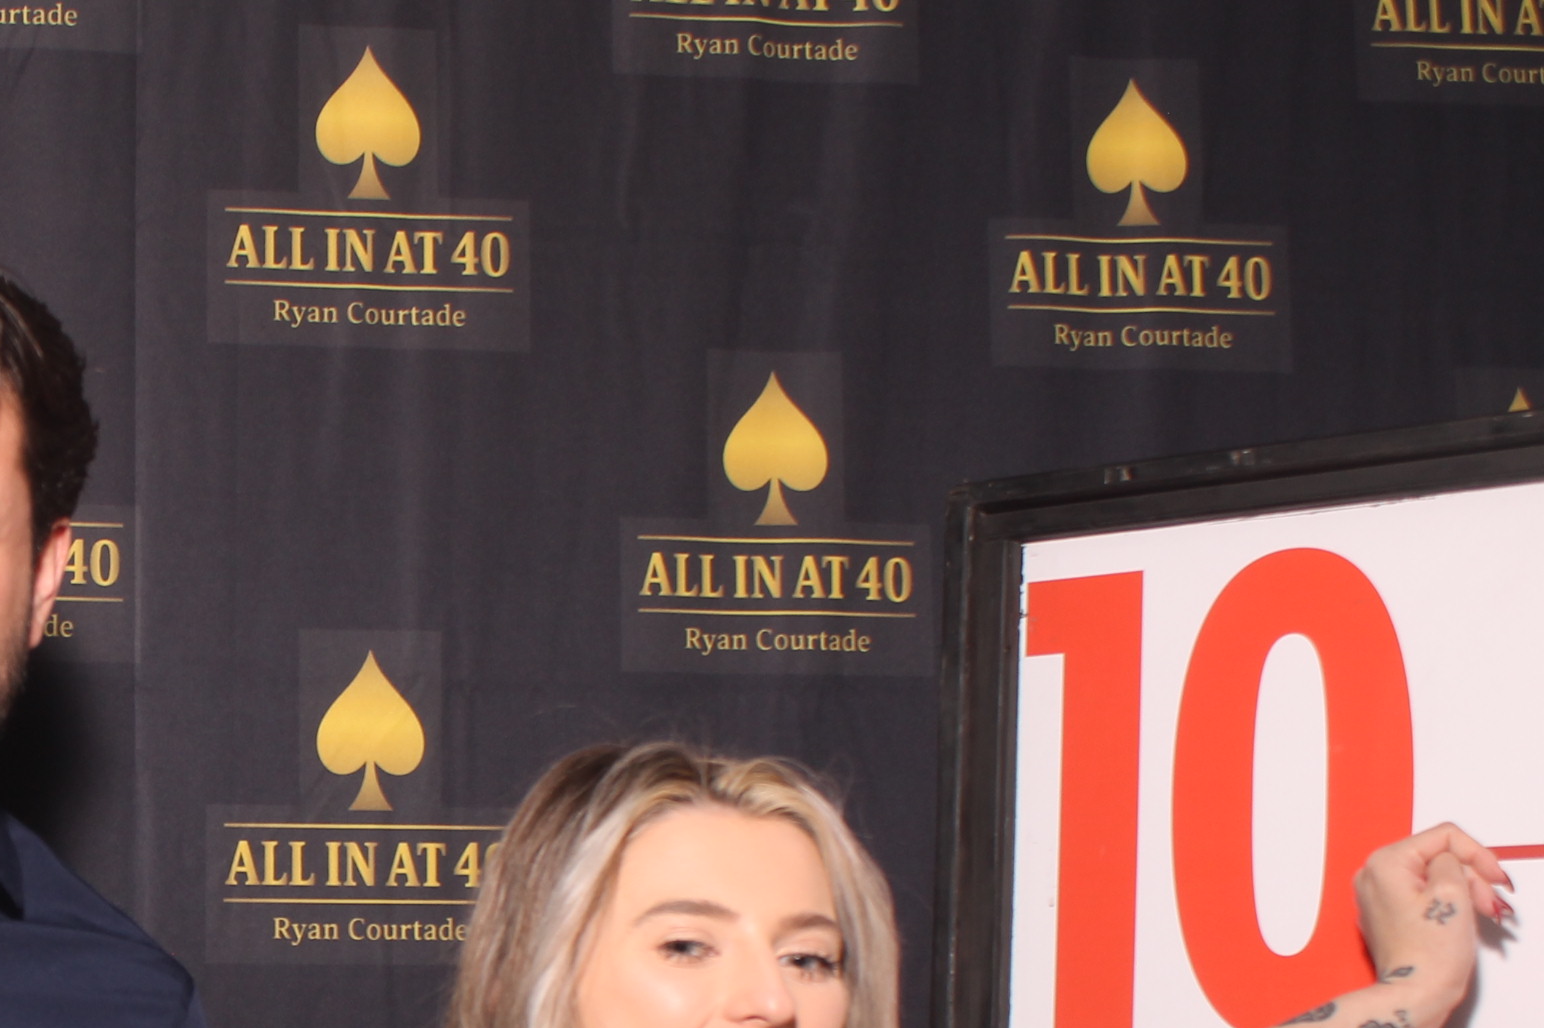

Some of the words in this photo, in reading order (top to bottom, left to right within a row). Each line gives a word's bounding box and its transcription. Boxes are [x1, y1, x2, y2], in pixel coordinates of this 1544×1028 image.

[1371, 0, 1452, 33] ALL
[1460, 0, 1504, 34] IN
[1513, 0, 1544, 36] A
[676, 33, 739, 60] Ryan
[747, 34, 858, 61] Courtade
[1416, 60, 1474, 87] Ryan
[1481, 62, 1544, 85] Court
[226, 224, 314, 270] ALL
[324, 228, 375, 272] IN
[384, 230, 443, 275] AT
[450, 231, 510, 278] 40
[1008, 250, 1089, 296] ALL
[1097, 254, 1146, 297] IN
[1156, 254, 1210, 297] AT
[1216, 256, 1272, 301] 40
[273, 300, 338, 328] Ryan
[347, 302, 466, 327] Courtade
[1054, 324, 1113, 351] Ryan
[1120, 325, 1234, 349] Courtade
[64, 538, 121, 587] 40
[639, 552, 724, 598] ALL
[732, 555, 784, 599] IN
[792, 555, 850, 599] AT
[855, 556, 913, 603] 40
[685, 627, 748, 656] Ryan
[756, 628, 871, 652] Courtade
[225, 840, 315, 886] ALL
[325, 841, 377, 887] IN
[386, 842, 446, 888] AT
[454, 842, 500, 888] 4
[273, 917, 339, 946] Ryan
[348, 918, 466, 942] Courtade
